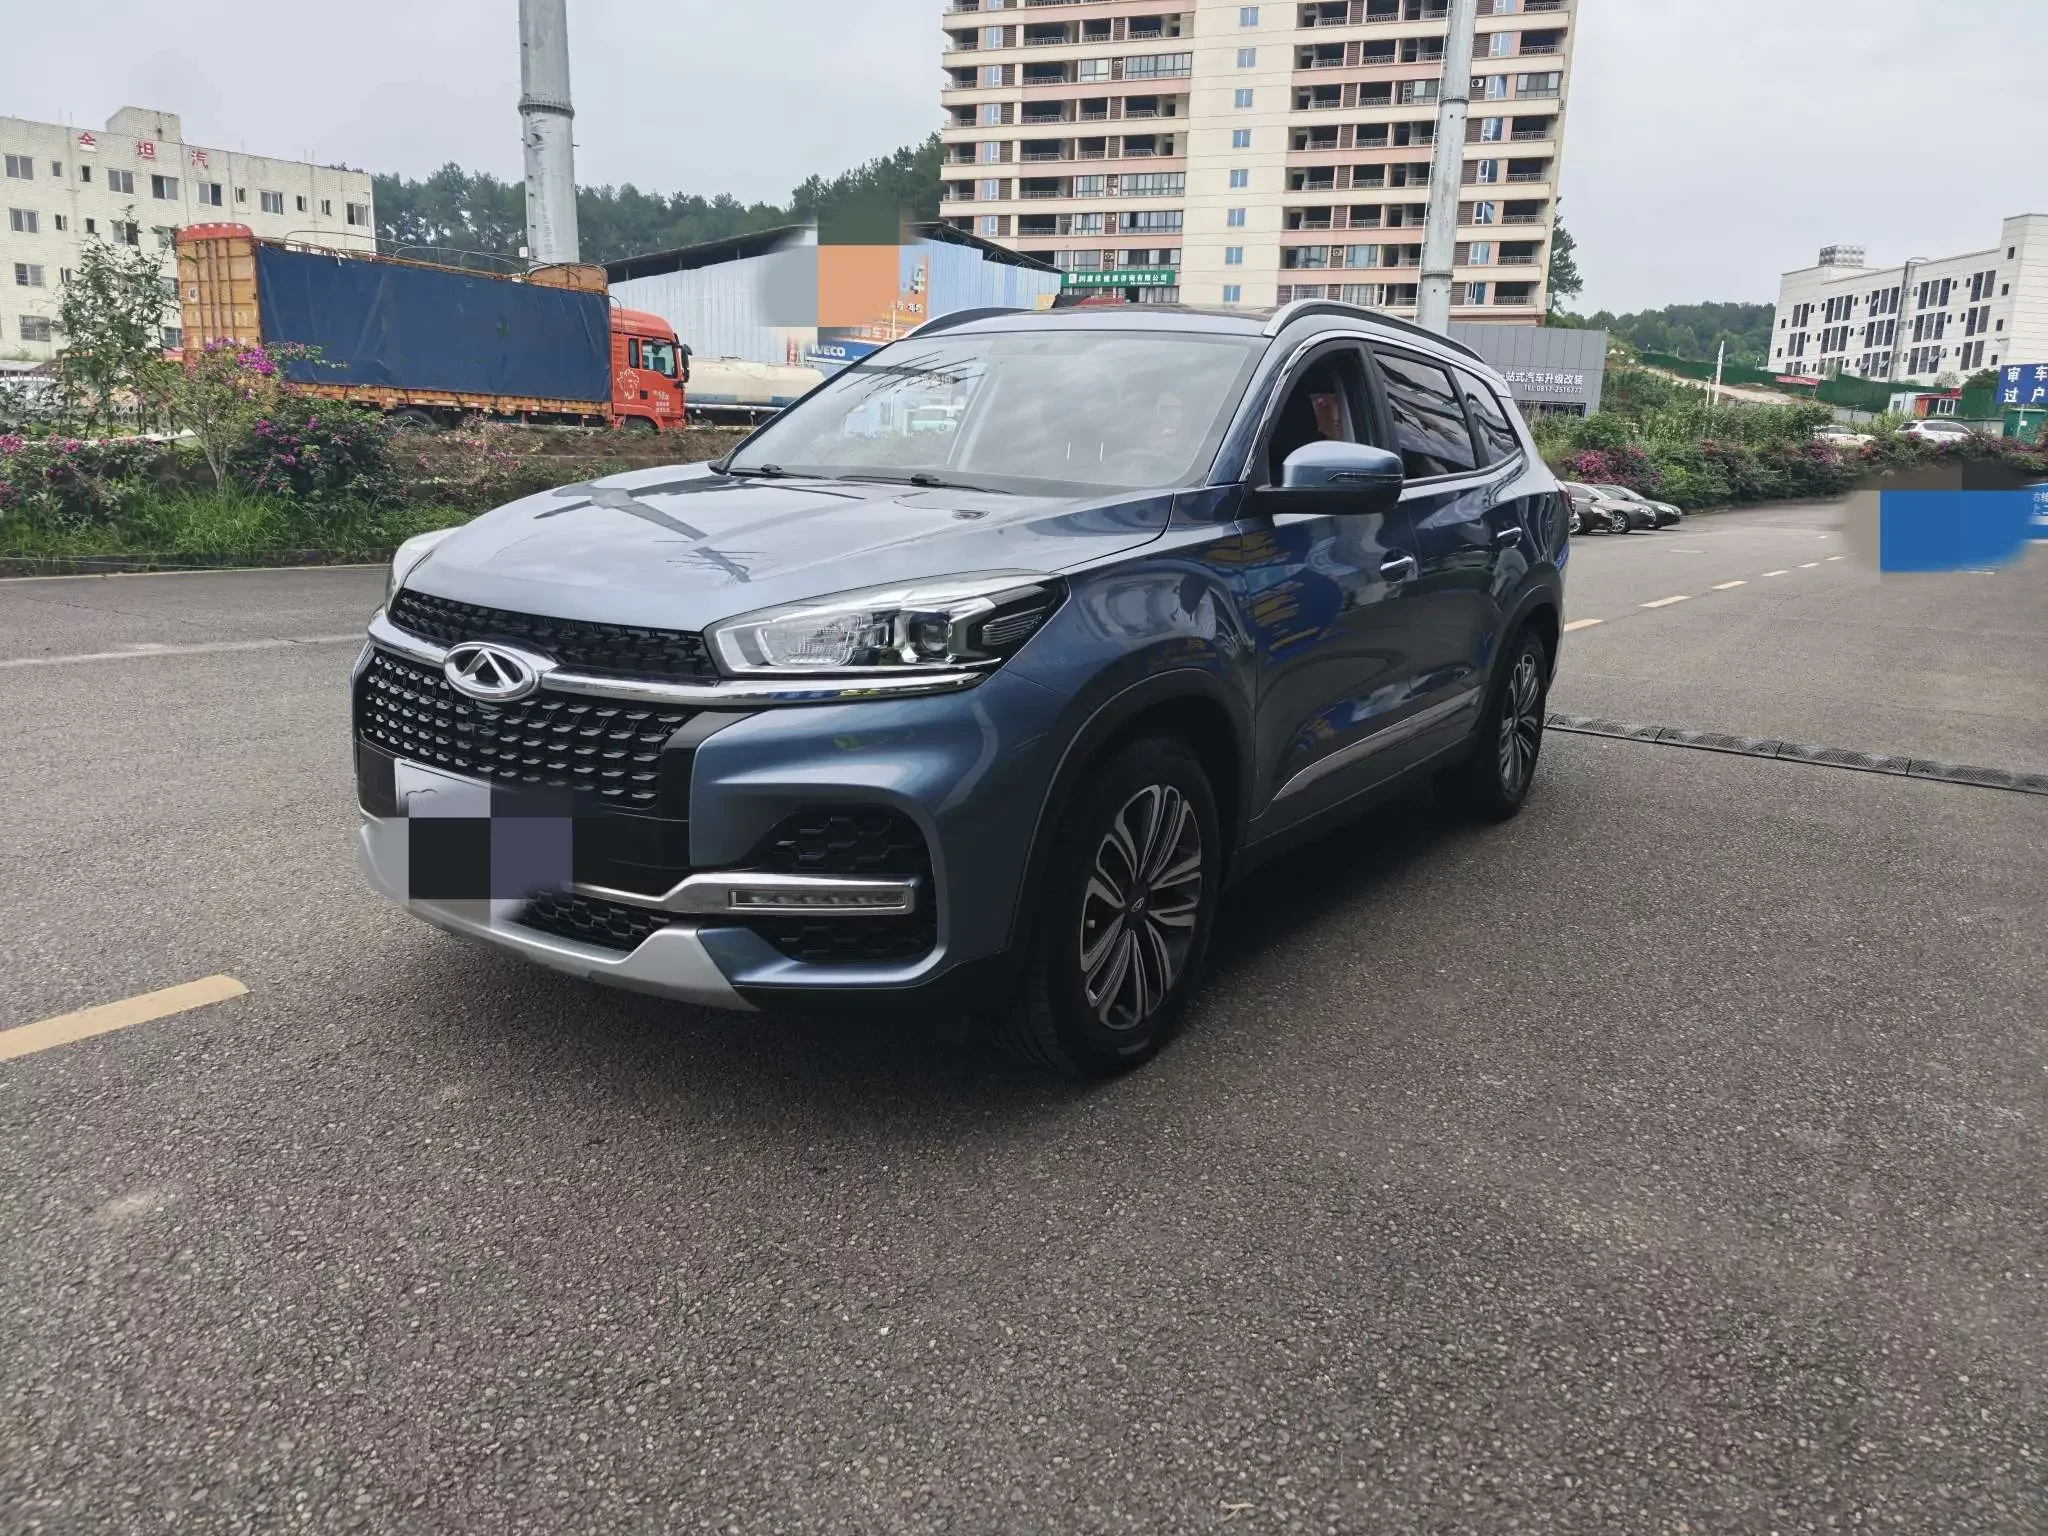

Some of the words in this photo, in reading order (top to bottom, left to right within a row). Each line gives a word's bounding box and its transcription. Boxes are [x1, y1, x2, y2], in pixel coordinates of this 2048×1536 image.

[811, 343, 846, 357] IVECO
[2007, 365, 2048, 383] 审车
[2003, 386, 2045, 403] 过户
